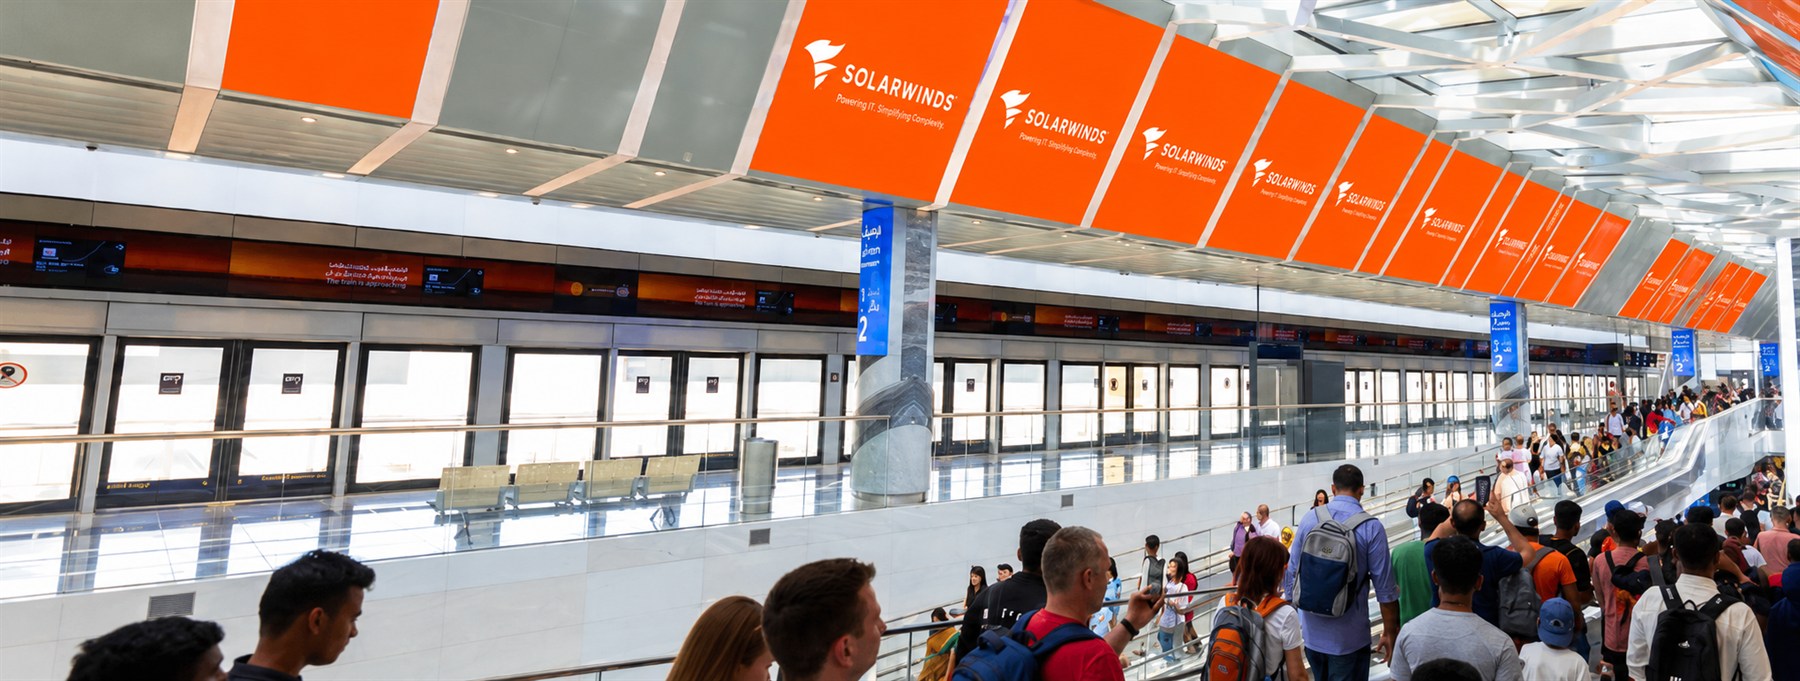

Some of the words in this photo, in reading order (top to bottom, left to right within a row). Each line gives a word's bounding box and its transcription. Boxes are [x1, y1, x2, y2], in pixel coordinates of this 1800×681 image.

[842, 64, 955, 112] SOLARWINDS
[836, 93, 867, 111] Powering
[877, 104, 912, 123] Simplifying
[1025, 108, 1107, 145] SOLARWINDS
[1161, 143, 1226, 172] SOLARWINDS
[1266, 171, 1316, 195] SOLARWINDS
[858, 316, 868, 342] 2
[1494, 354, 1503, 367] 2
[1676, 363, 1684, 372] 2
